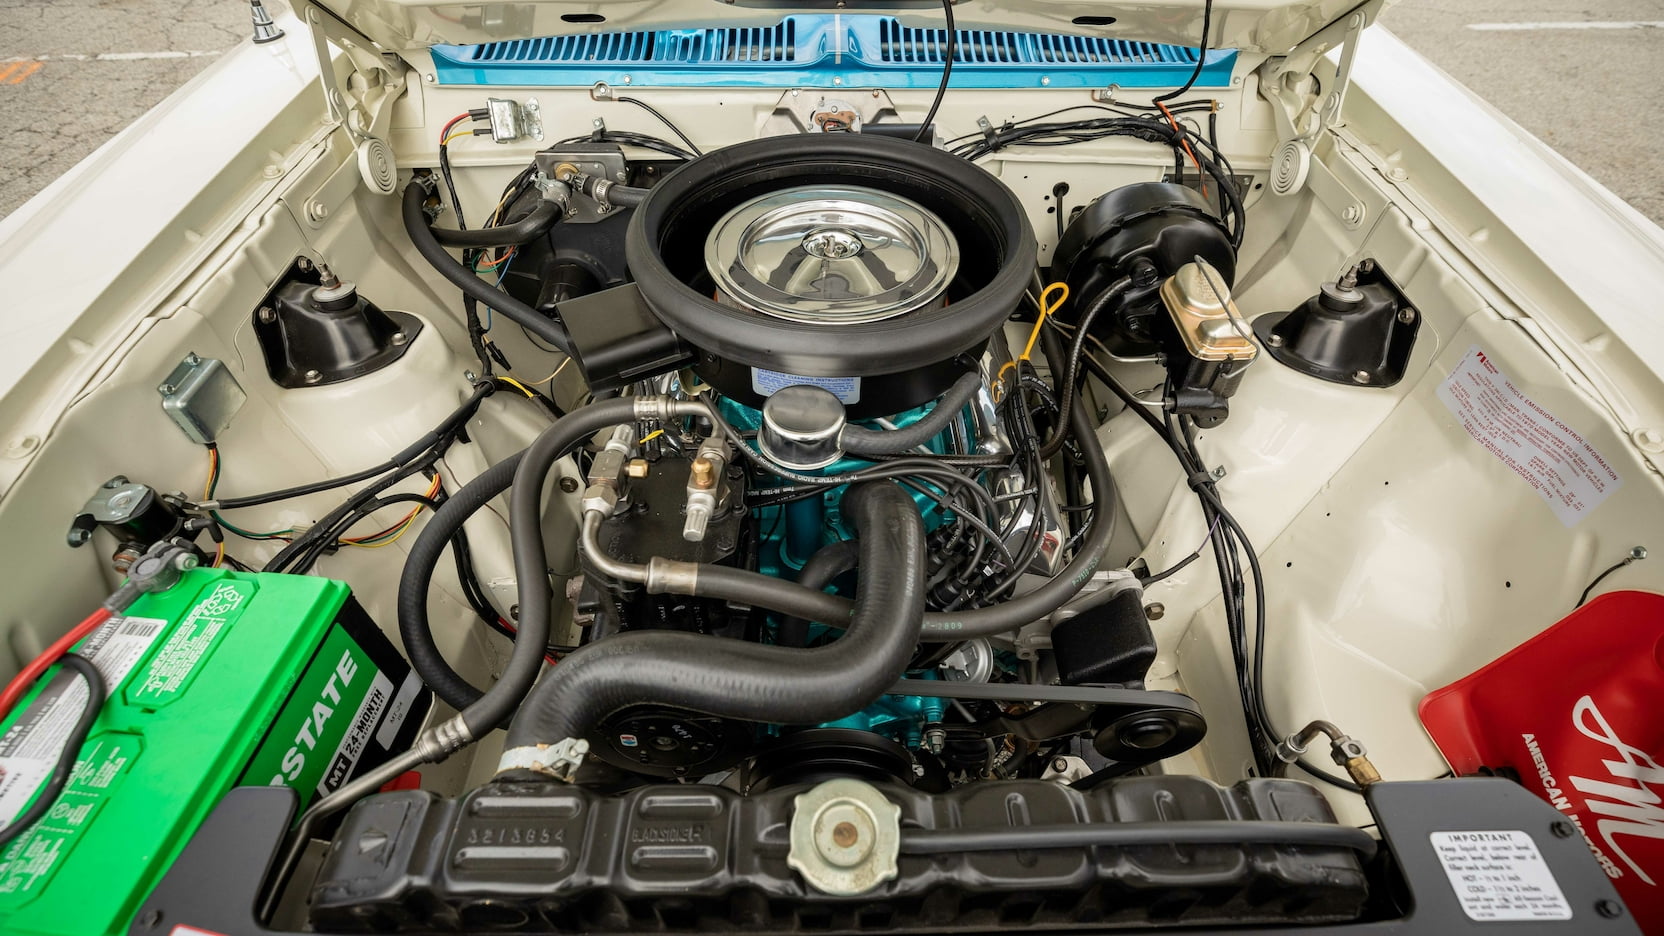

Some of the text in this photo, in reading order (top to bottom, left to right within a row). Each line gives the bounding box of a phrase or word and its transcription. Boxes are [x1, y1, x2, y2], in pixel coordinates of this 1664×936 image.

[758, 368, 786, 378] ARTRIDGE
[1494, 394, 1515, 414] APPLICABLE
[1533, 426, 1549, 440] MODEL
[1549, 439, 1562, 450] YEAR
[1562, 448, 1573, 459] NEW
[1572, 458, 1586, 473] MOTOR
[1584, 473, 1603, 493] VEHICLES
[1503, 380, 1524, 400] VEHICLE
[1523, 398, 1555, 422] EMISSION
[1554, 420, 1584, 444] CONTROL
[1583, 442, 1618, 481] INFORMATION
[1538, 424, 1565, 446] CONFORMS
[1481, 436, 1504, 455] MANUAL
[1504, 454, 1516, 464] FOR
[1516, 463, 1553, 498] INSTRUCTIONS
[1504, 459, 1539, 489] CORPORATION
[82, 616, 120, 658] 4-MONTH
[345, 688, 383, 754] 24-MONTH
[360, 694, 386, 739] REPLACEMENT
[329, 758, 348, 788] MT
[1522, 734, 1572, 811] AMERICAN
